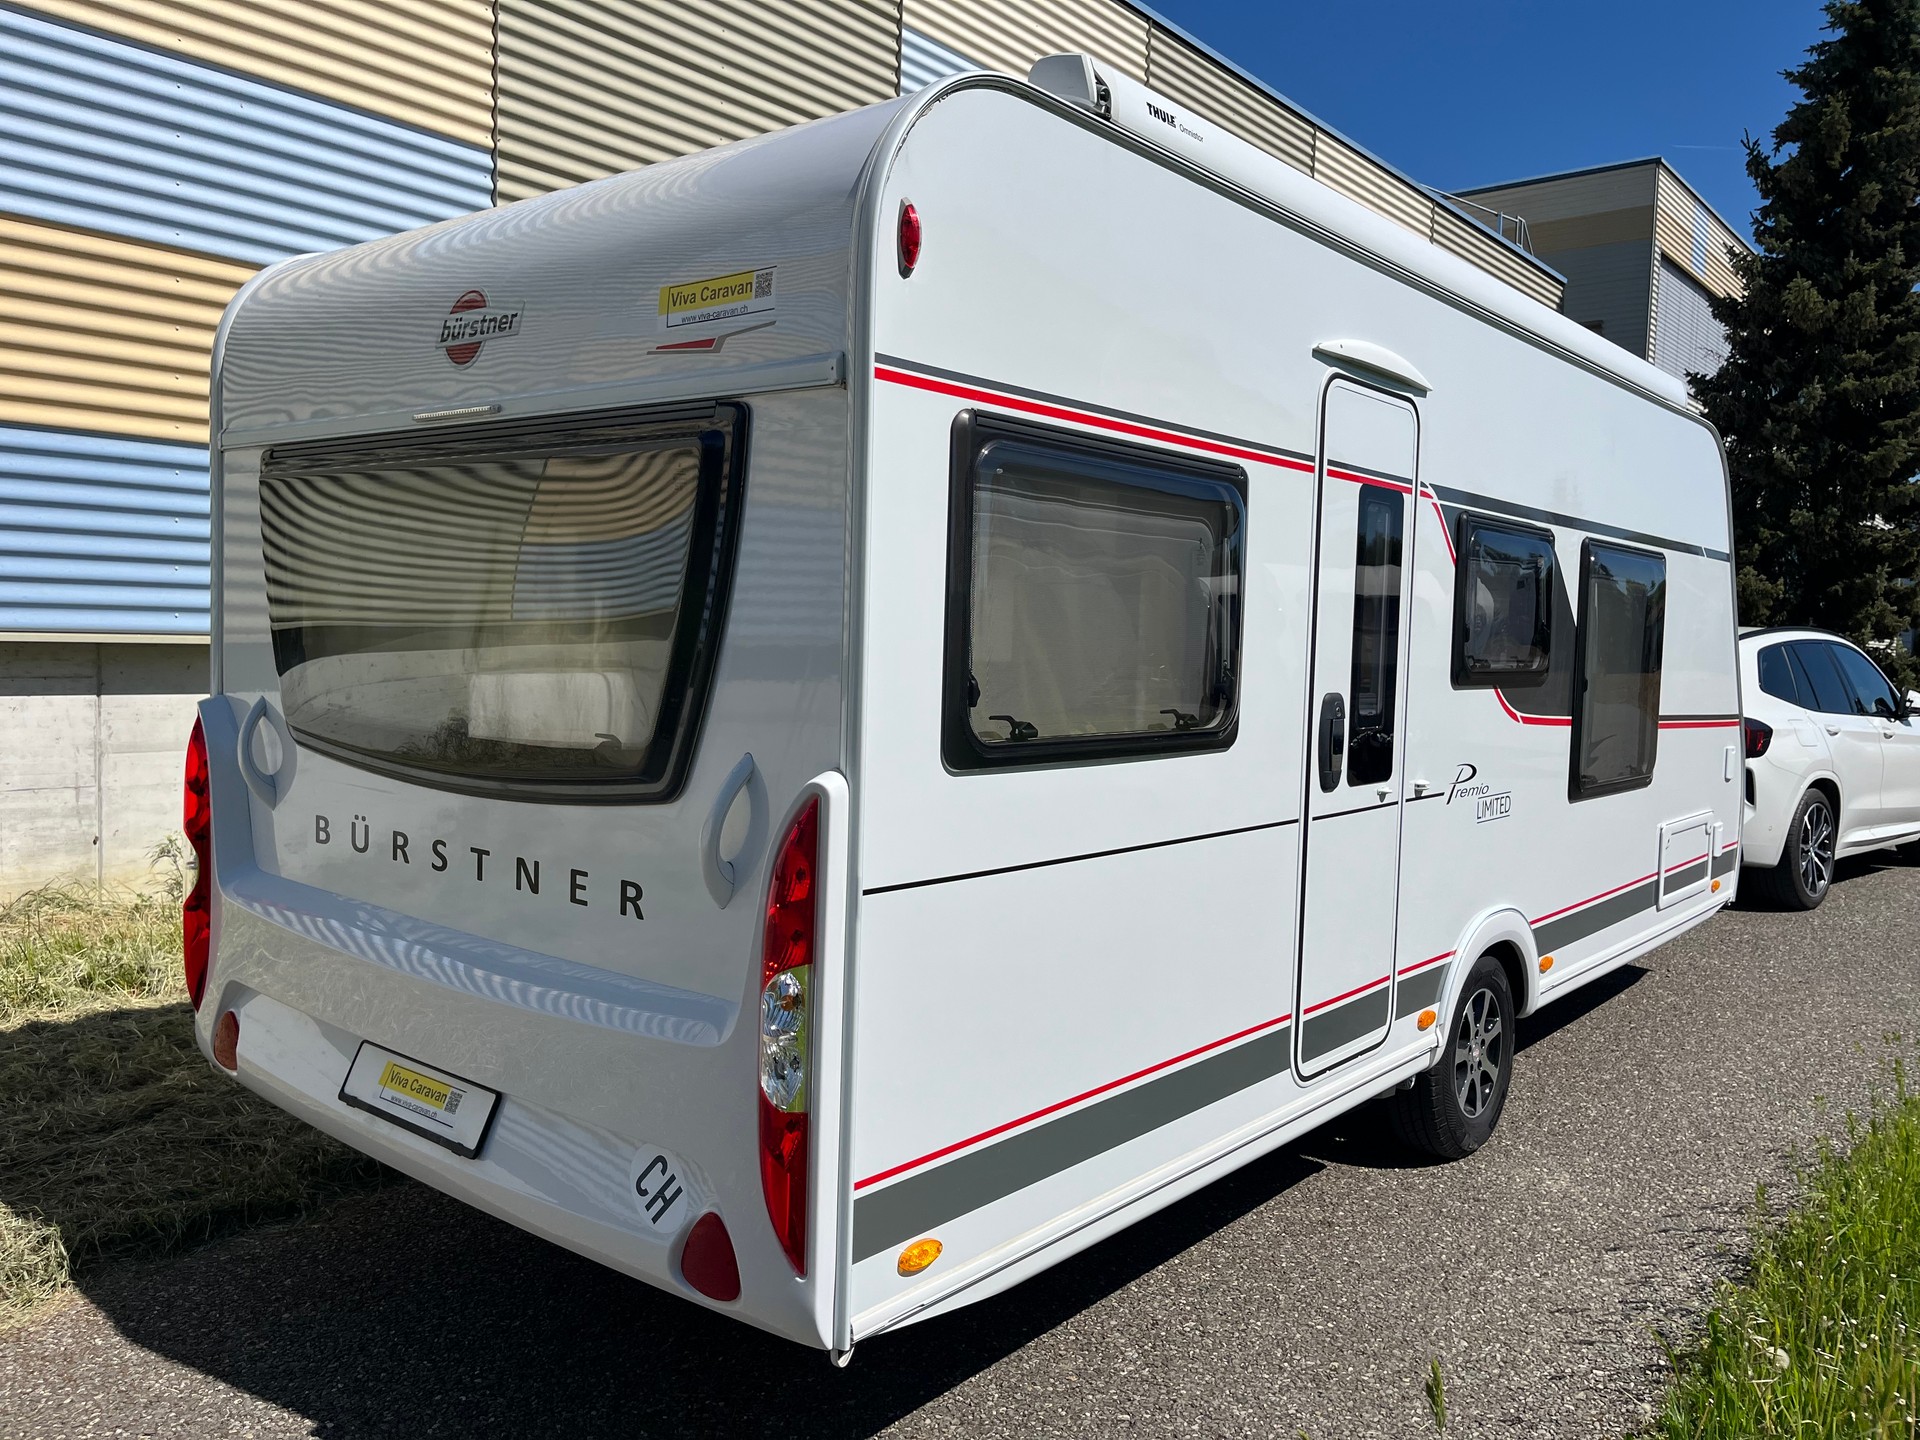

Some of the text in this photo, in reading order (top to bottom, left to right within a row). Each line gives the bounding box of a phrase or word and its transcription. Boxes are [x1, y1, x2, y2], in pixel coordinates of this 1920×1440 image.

[1146, 101, 1204, 142] THULE Omnistor
[671, 281, 753, 307] Viva Caravan
[440, 312, 518, 343] bürstner
[1446, 763, 1490, 805] Premio
[1476, 795, 1512, 820] LIMITED
[315, 814, 645, 921] BÜRSTNER
[389, 1070, 448, 1104] Viva Caravan
[635, 1154, 683, 1225] CH
